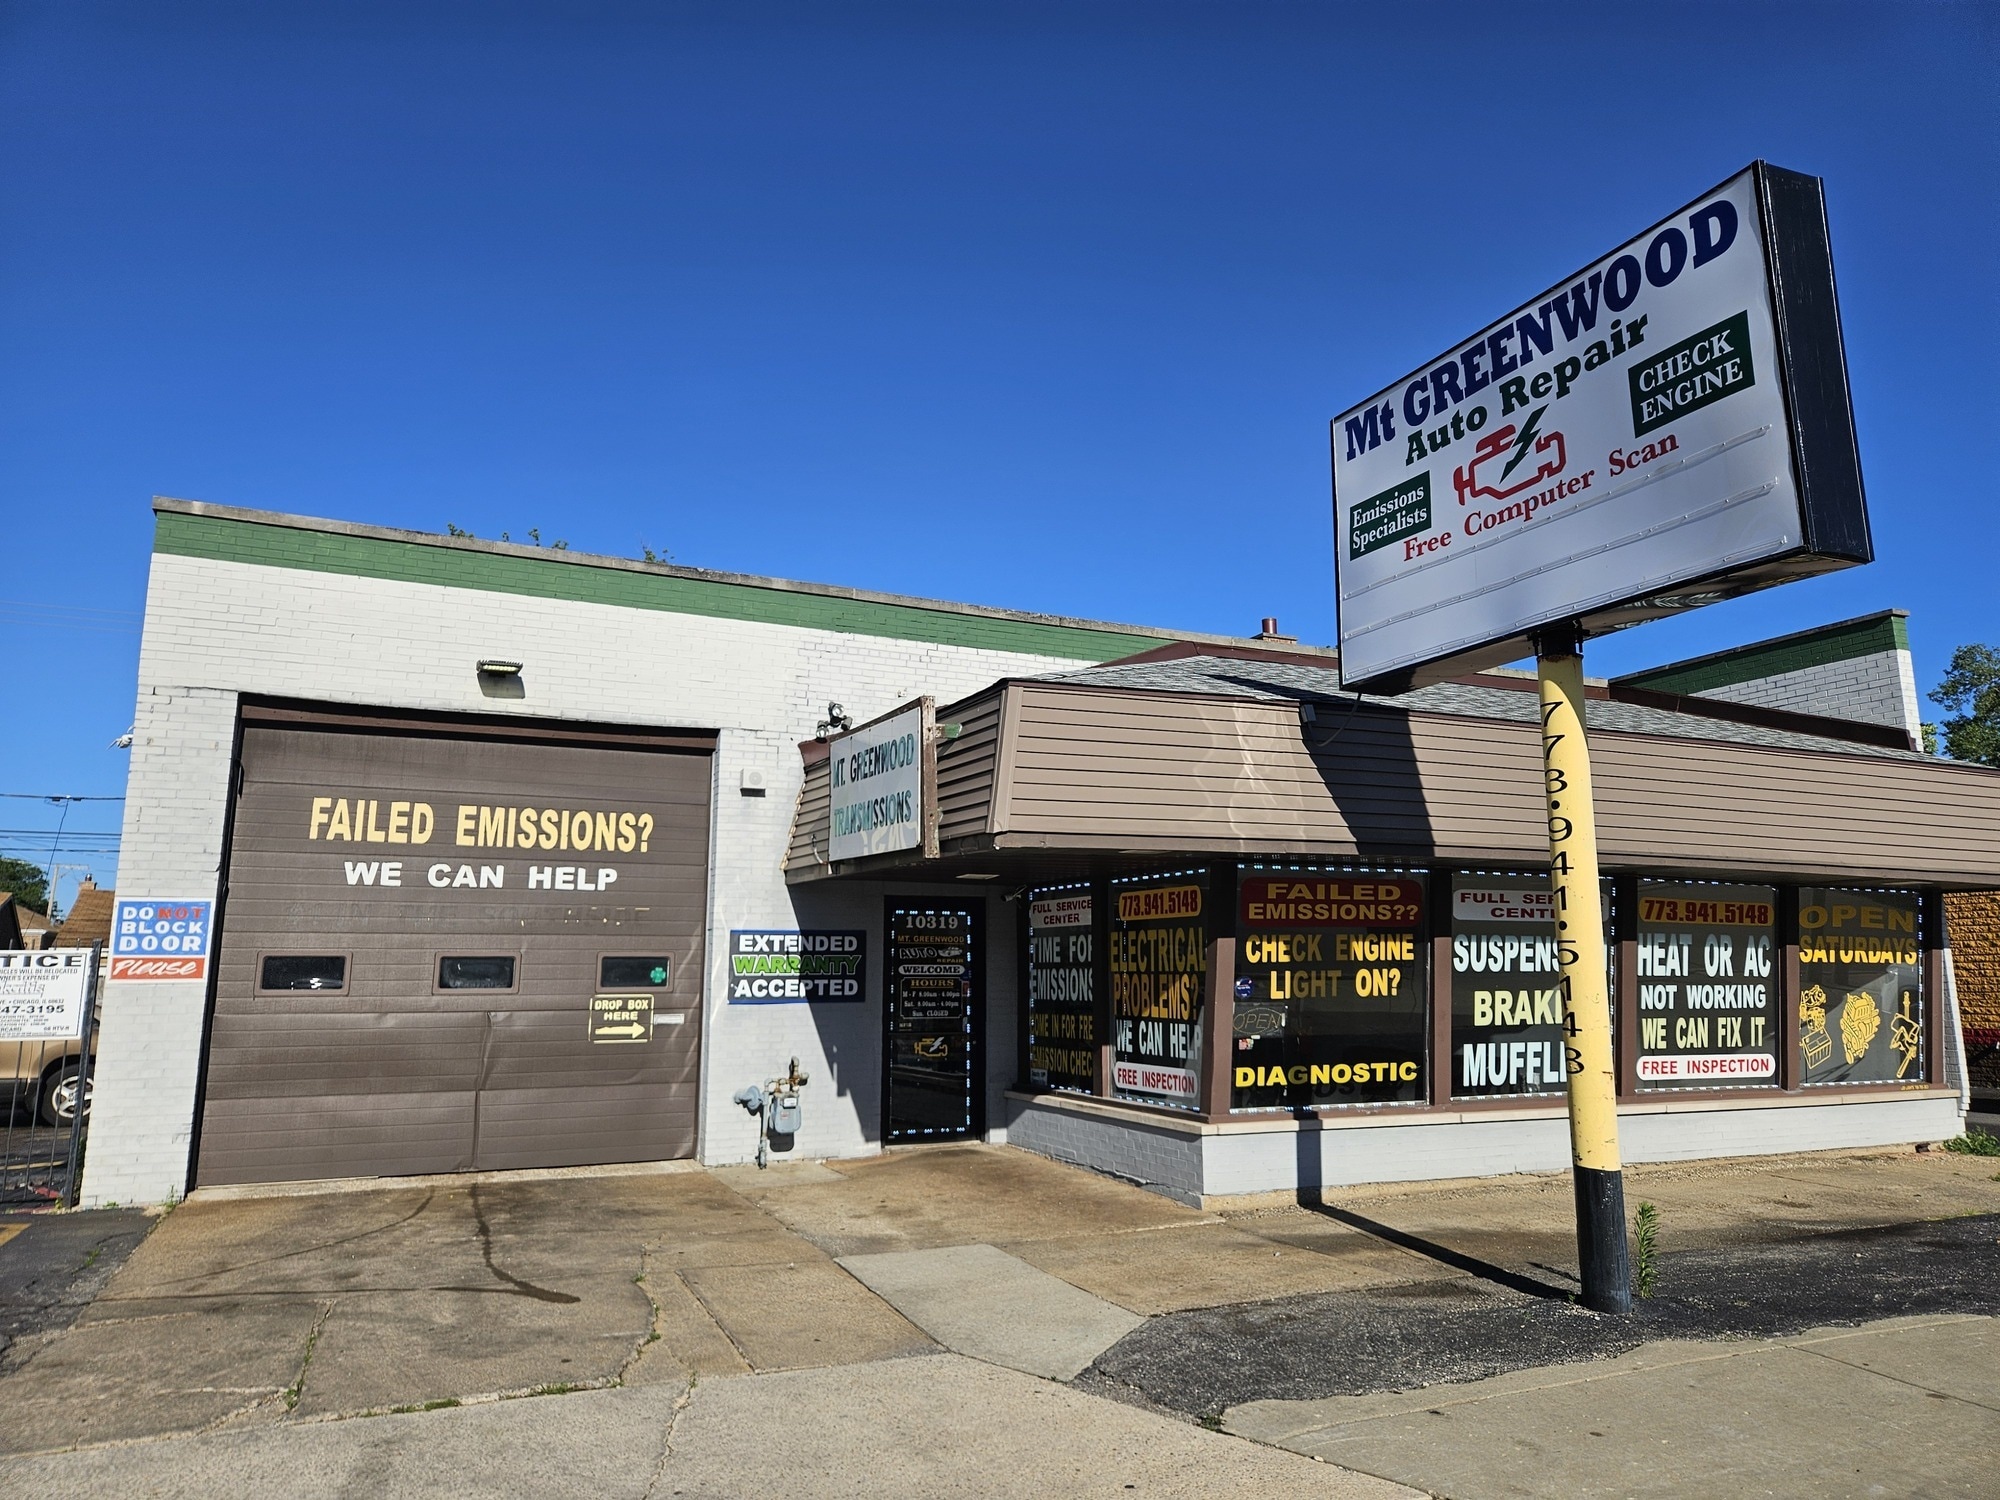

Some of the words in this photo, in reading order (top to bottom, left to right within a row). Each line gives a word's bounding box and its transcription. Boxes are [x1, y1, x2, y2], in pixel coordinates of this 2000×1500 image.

[1345, 407, 1395, 462] Mt
[1402, 199, 1739, 427] GREENWOOD
[1638, 329, 1734, 393] CHECK
[1405, 405, 1488, 466] Auto
[1499, 313, 1649, 416] Repair
[1640, 358, 1744, 424] ENGINE
[1352, 485, 1425, 528] Emissions
[1403, 529, 1452, 561] Free
[1464, 471, 1595, 537] Computer
[1608, 435, 1680, 478] Scan
[1352, 506, 1428, 550] Specialists
[833, 758, 846, 789] MT.
[850, 733, 915, 784] GREENWOOD
[309, 797, 434, 845] FAILED
[456, 805, 655, 853] EMISSIONS?
[834, 790, 912, 838] TRANSMISSIONS
[344, 861, 403, 887] WE
[427, 863, 505, 889] CAN
[528, 866, 618, 891] HELP
[1121, 889, 1198, 917] 773.941.5148
[1267, 883, 1401, 900] FAILED
[1460, 892, 1510, 904] FULL
[122, 906, 154, 920] DO
[157, 906, 205, 920] NOT
[1033, 903, 1052, 915] FULL
[1056, 899, 1092, 912] SERVICE
[1043, 913, 1080, 925] CENTER
[1249, 903, 1419, 921] EMISSIONS??
[1644, 899, 1769, 924] 773.941.5148
[1799, 905, 1914, 933] OPEN
[121, 921, 204, 934] BLOCK
[906, 915, 958, 929] 10319
[118, 935, 202, 951] DOOR
[739, 934, 858, 952] EXTENDED
[897, 935, 911, 944] MT.
[913, 935, 965, 944] GREENWOOD
[1030, 936, 1061, 963] TIME
[1110, 927, 1206, 972] ELECTRICAL
[1246, 933, 1322, 963] CHECK
[1336, 933, 1414, 961] ENGINE
[1799, 935, 1918, 965] SATURDAYS
[732, 954, 862, 976] WARRANTY
[899, 946, 938, 959] AUTO
[1637, 933, 1693, 977] HEAT
[1704, 933, 1734, 978] OR
[1744, 934, 1772, 978] AC
[112, 959, 197, 976] Please
[902, 965, 961, 974] WELCOME
[734, 979, 859, 998] ACCEPTED
[910, 979, 955, 987] HOURS
[1270, 969, 1342, 1000] LIGHT
[1355, 968, 1401, 997] ON?
[594, 999, 623, 1011] DROP
[627, 999, 649, 1010] BOX
[1113, 973, 1199, 1020] PROBLEMS?
[1640, 984, 1678, 1010] NOT
[1686, 984, 1766, 1010] WORKING
[603, 1011, 639, 1021] HERE
[1051, 1014, 1059, 1038] IN
[1061, 1014, 1076, 1039] FOR
[1233, 1013, 1282, 1031] OPEN
[1116, 1019, 1133, 1053] WE
[1139, 1020, 1163, 1057] CAN
[1170, 1022, 1203, 1060] HELP
[1641, 1017, 1667, 1050] WE
[1675, 1016, 1709, 1049] CAN
[1717, 1016, 1743, 1048] FIX
[1750, 1016, 1766, 1047] IT
[1235, 1061, 1418, 1087] DIAGNOSTIC
[1642, 1060, 1678, 1075] FREE
[1687, 1058, 1770, 1074] INSPECTION
[1117, 1068, 1138, 1086] FREE
[1142, 1070, 1195, 1093] INSPECTION
